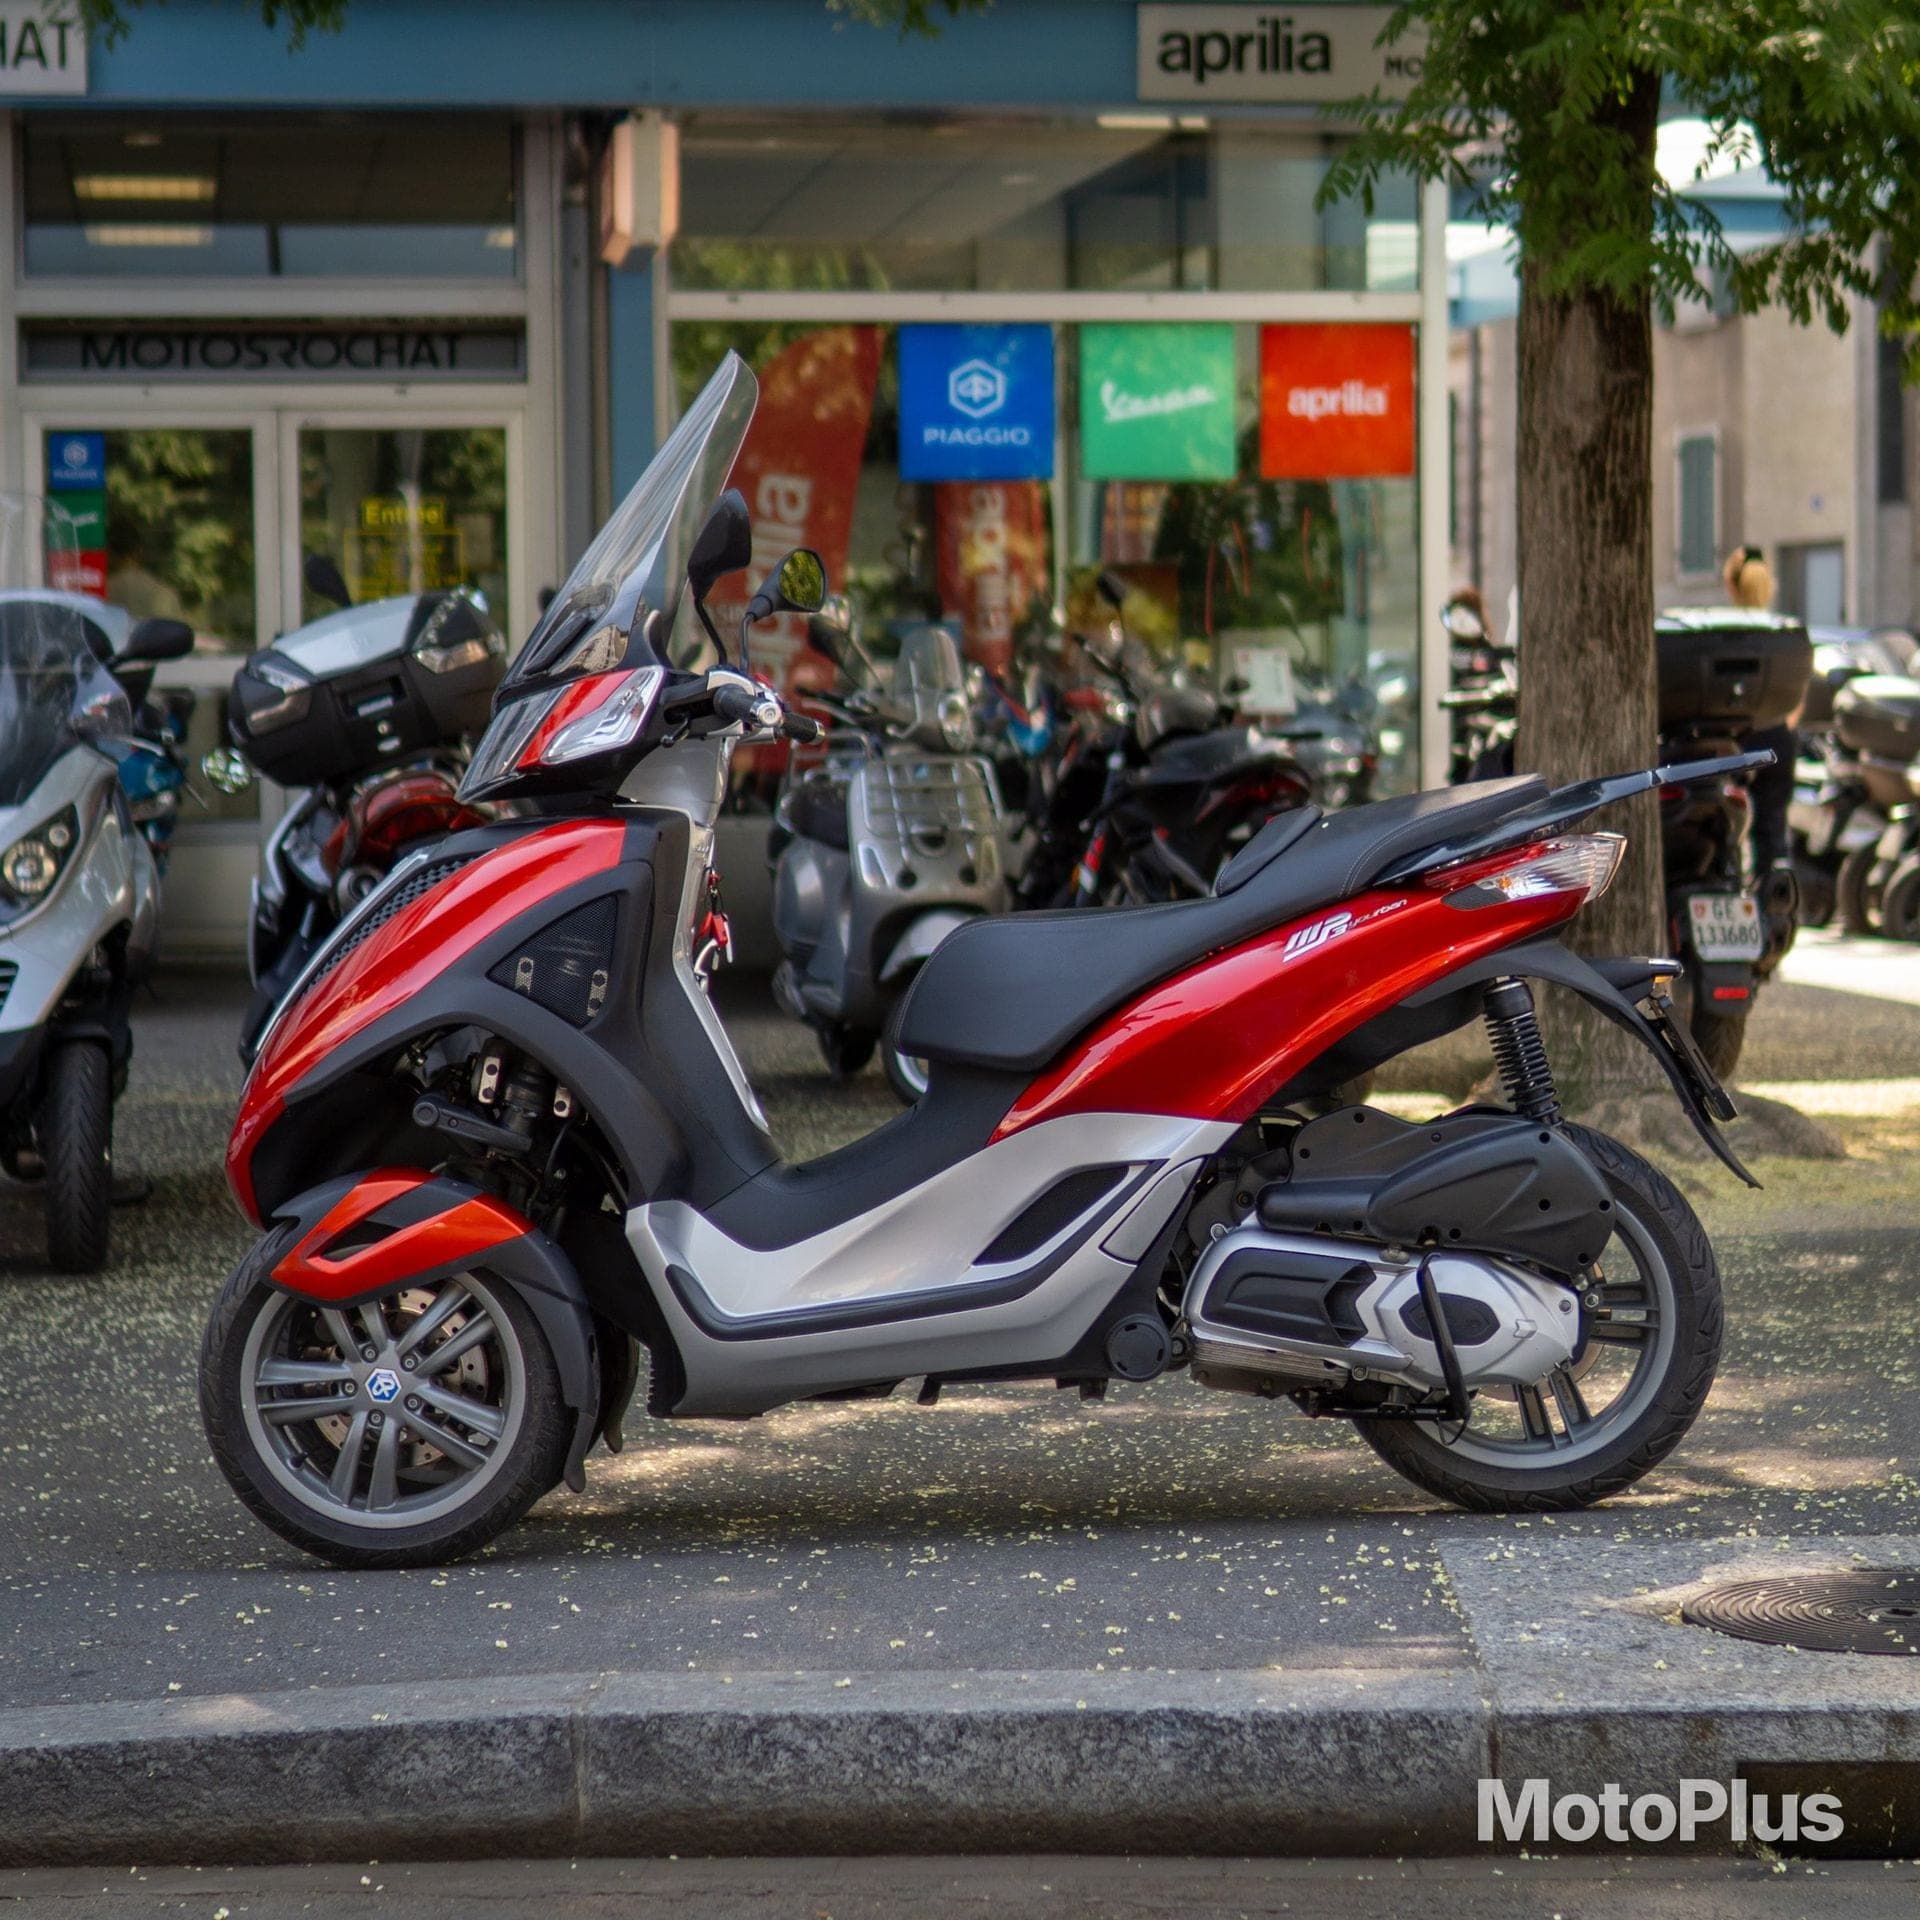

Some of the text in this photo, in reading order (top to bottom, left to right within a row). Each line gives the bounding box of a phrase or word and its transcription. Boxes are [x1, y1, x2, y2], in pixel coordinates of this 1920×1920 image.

[0, 18, 74, 69] AT
[1157, 16, 1332, 84] aprilia
[1100, 378, 1219, 424] Vespa
[1286, 379, 1389, 422] aprilia
[922, 427, 1032, 446] PIAGGIO
[365, 500, 440, 526] Ente
[1712, 896, 1738, 920] GE
